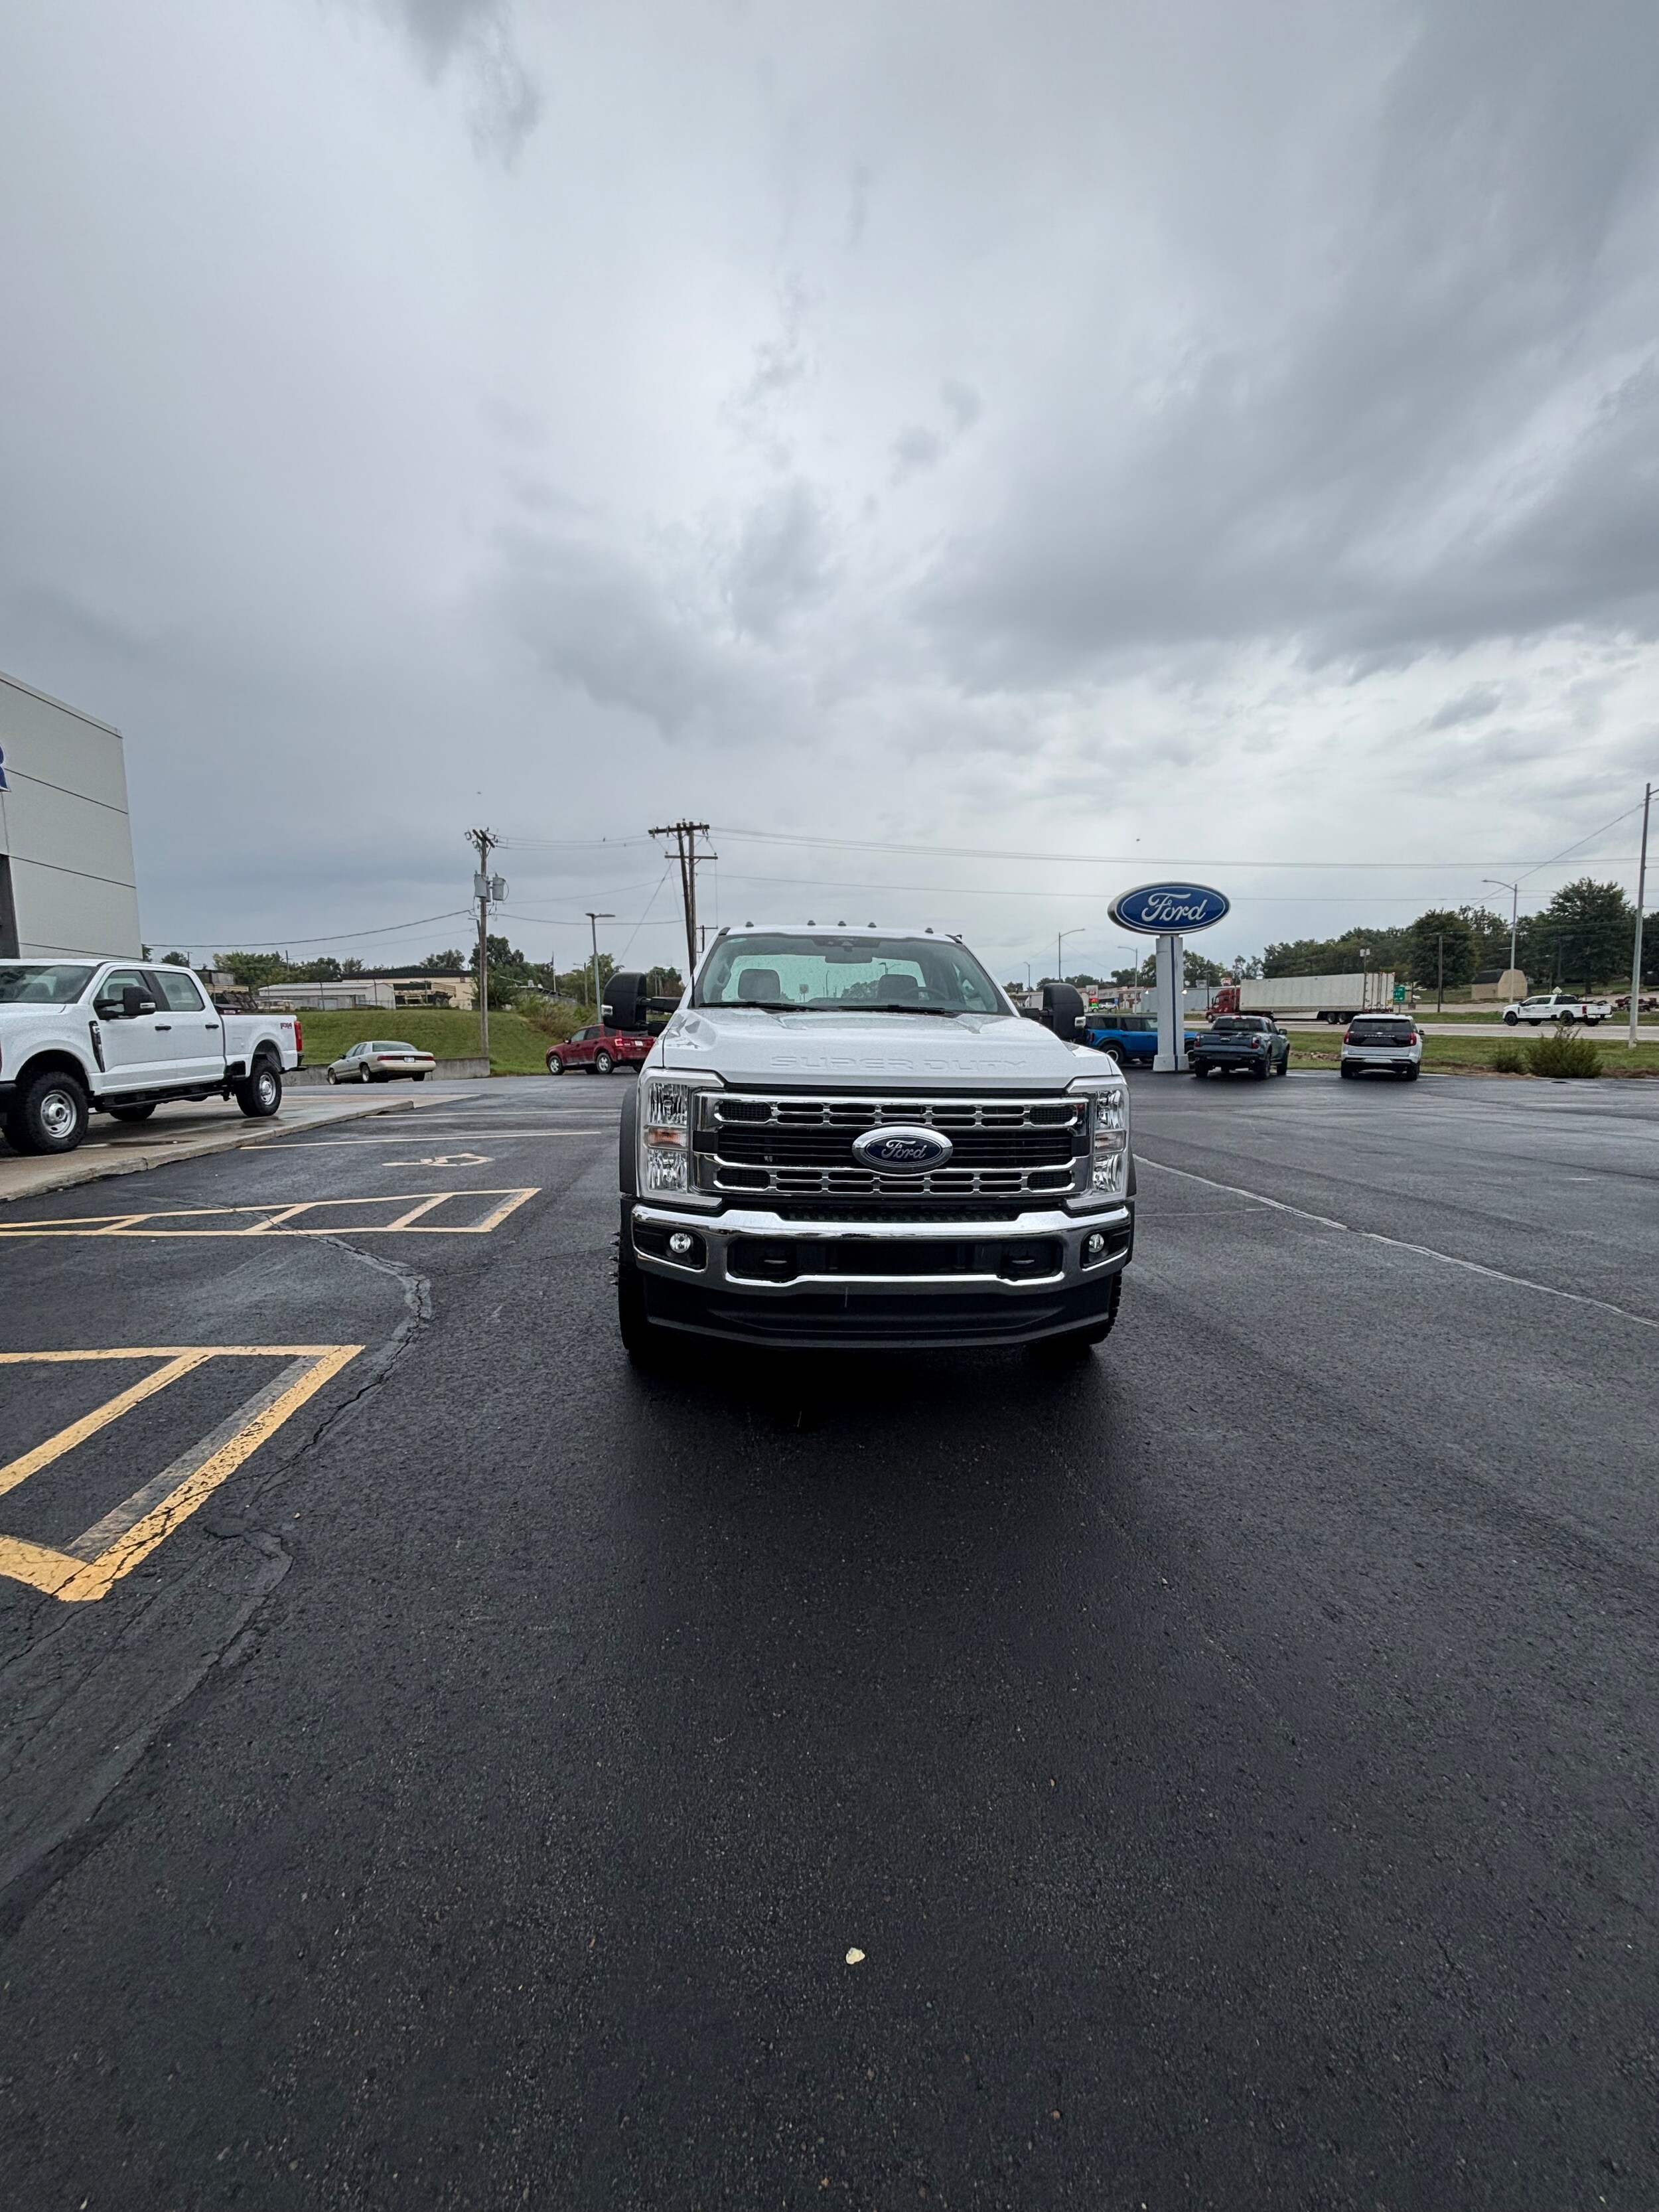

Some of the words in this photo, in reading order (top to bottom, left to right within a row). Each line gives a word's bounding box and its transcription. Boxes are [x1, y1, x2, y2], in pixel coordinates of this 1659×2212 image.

[1141, 893, 1208, 922] Ford
[770, 1055, 914, 1070] SUPER
[924, 1059, 1027, 1072] DUTY
[881, 1140, 928, 1159] Ford
